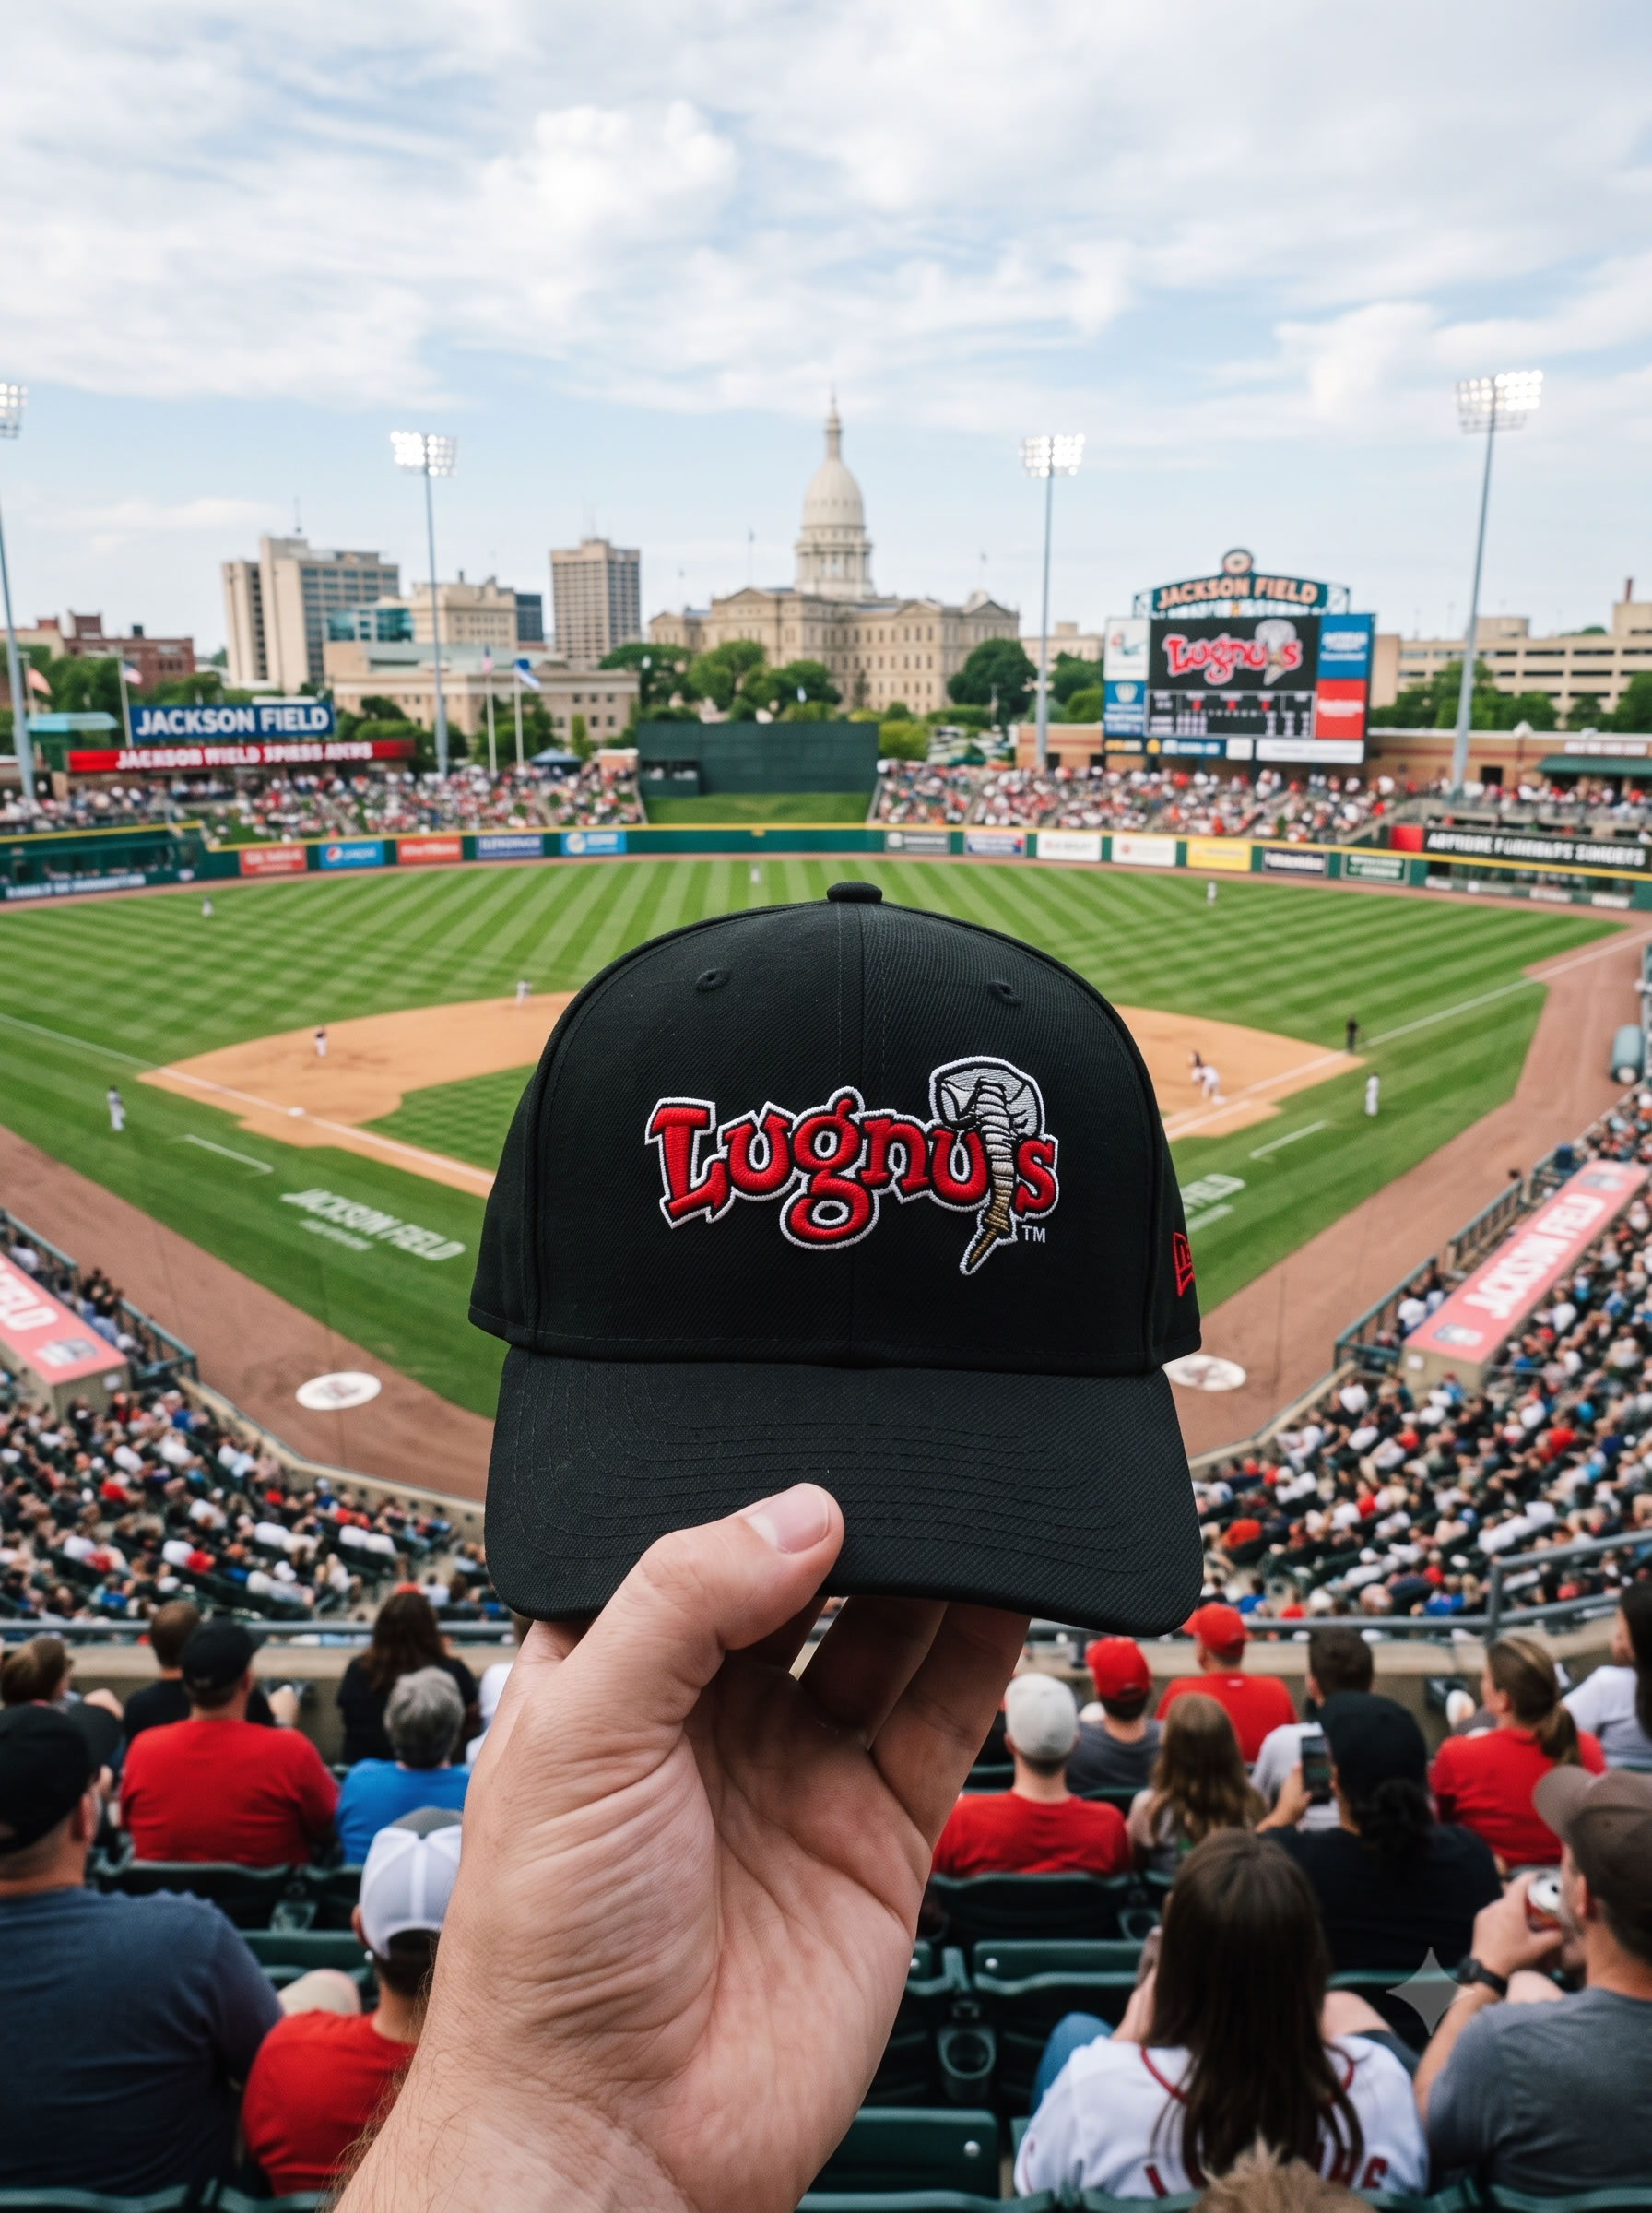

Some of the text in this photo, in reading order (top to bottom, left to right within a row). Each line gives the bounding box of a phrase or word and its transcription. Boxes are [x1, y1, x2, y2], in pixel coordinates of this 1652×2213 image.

[1157, 576, 1318, 610] JACKSON FIELD
[136, 705, 330, 736] JACKSON FIELD
[1534, 1192, 1607, 1239] FIELD
[376, 1223, 466, 1261] FIELD
[1021, 1225, 1046, 1244] TM
